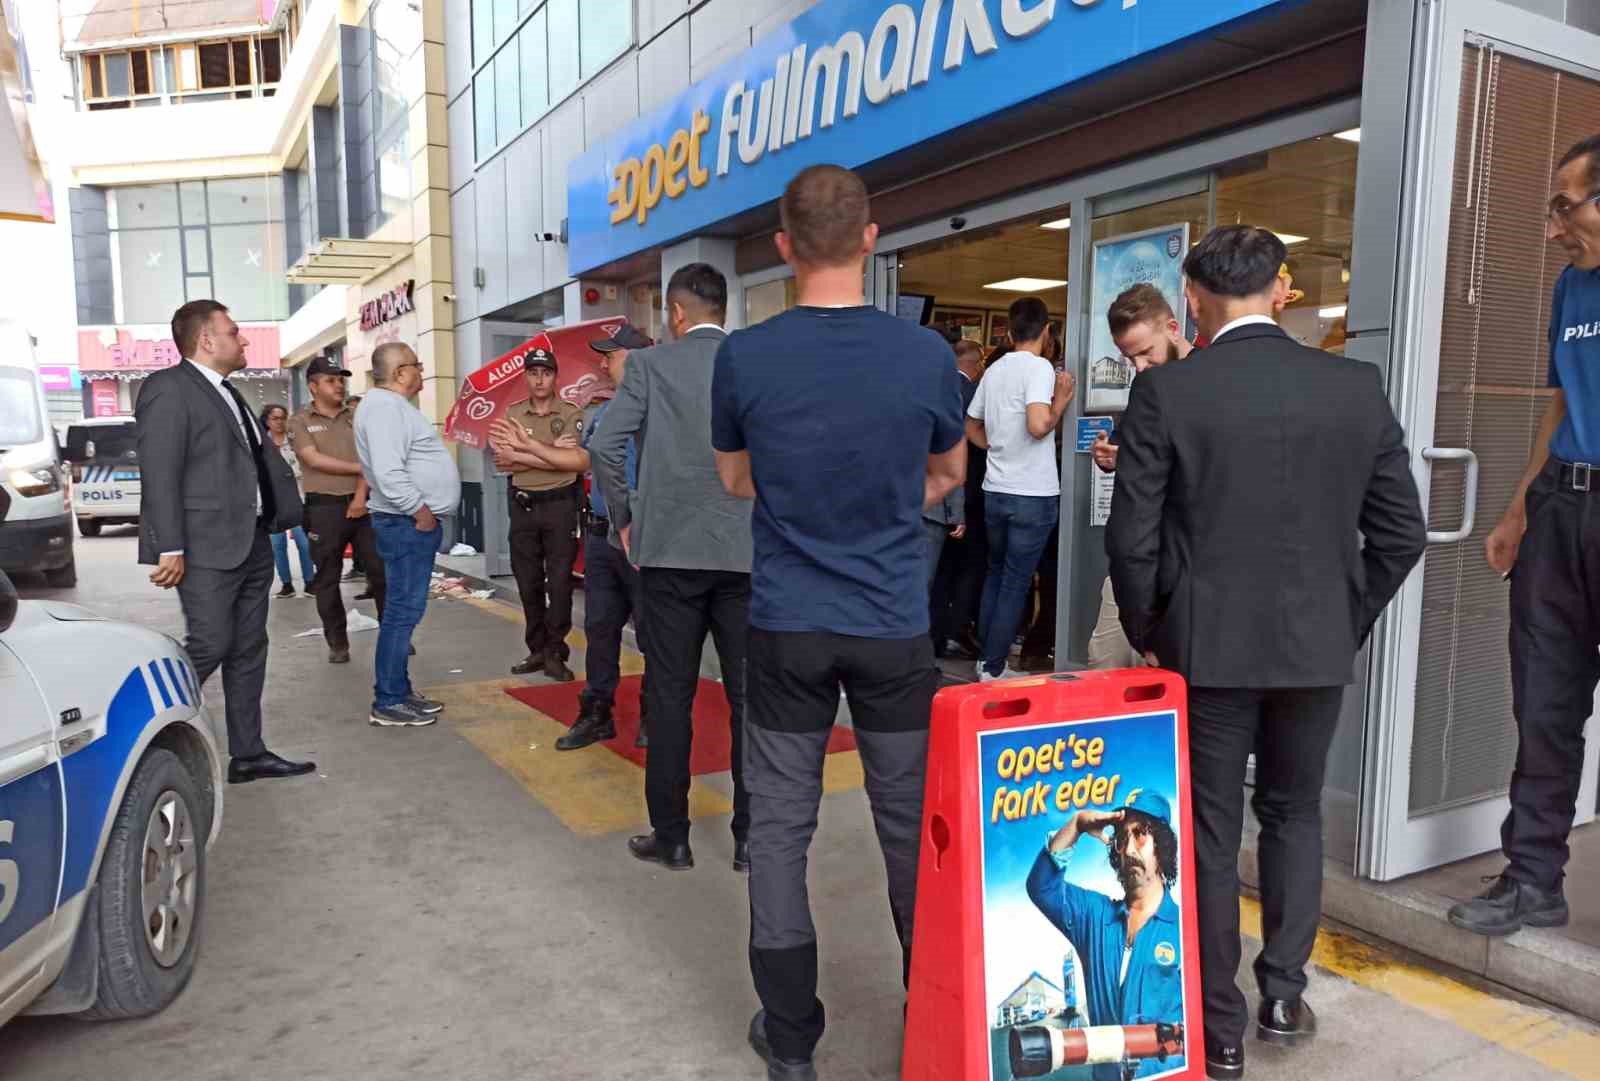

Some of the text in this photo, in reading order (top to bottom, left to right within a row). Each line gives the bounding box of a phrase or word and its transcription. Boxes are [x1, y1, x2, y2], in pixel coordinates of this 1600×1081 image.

[608, 0, 1102, 225] opet fullmark
[487, 347, 537, 384] ALGID
[997, 733, 1105, 782] opet'se
[991, 773, 1121, 824] fark eder
